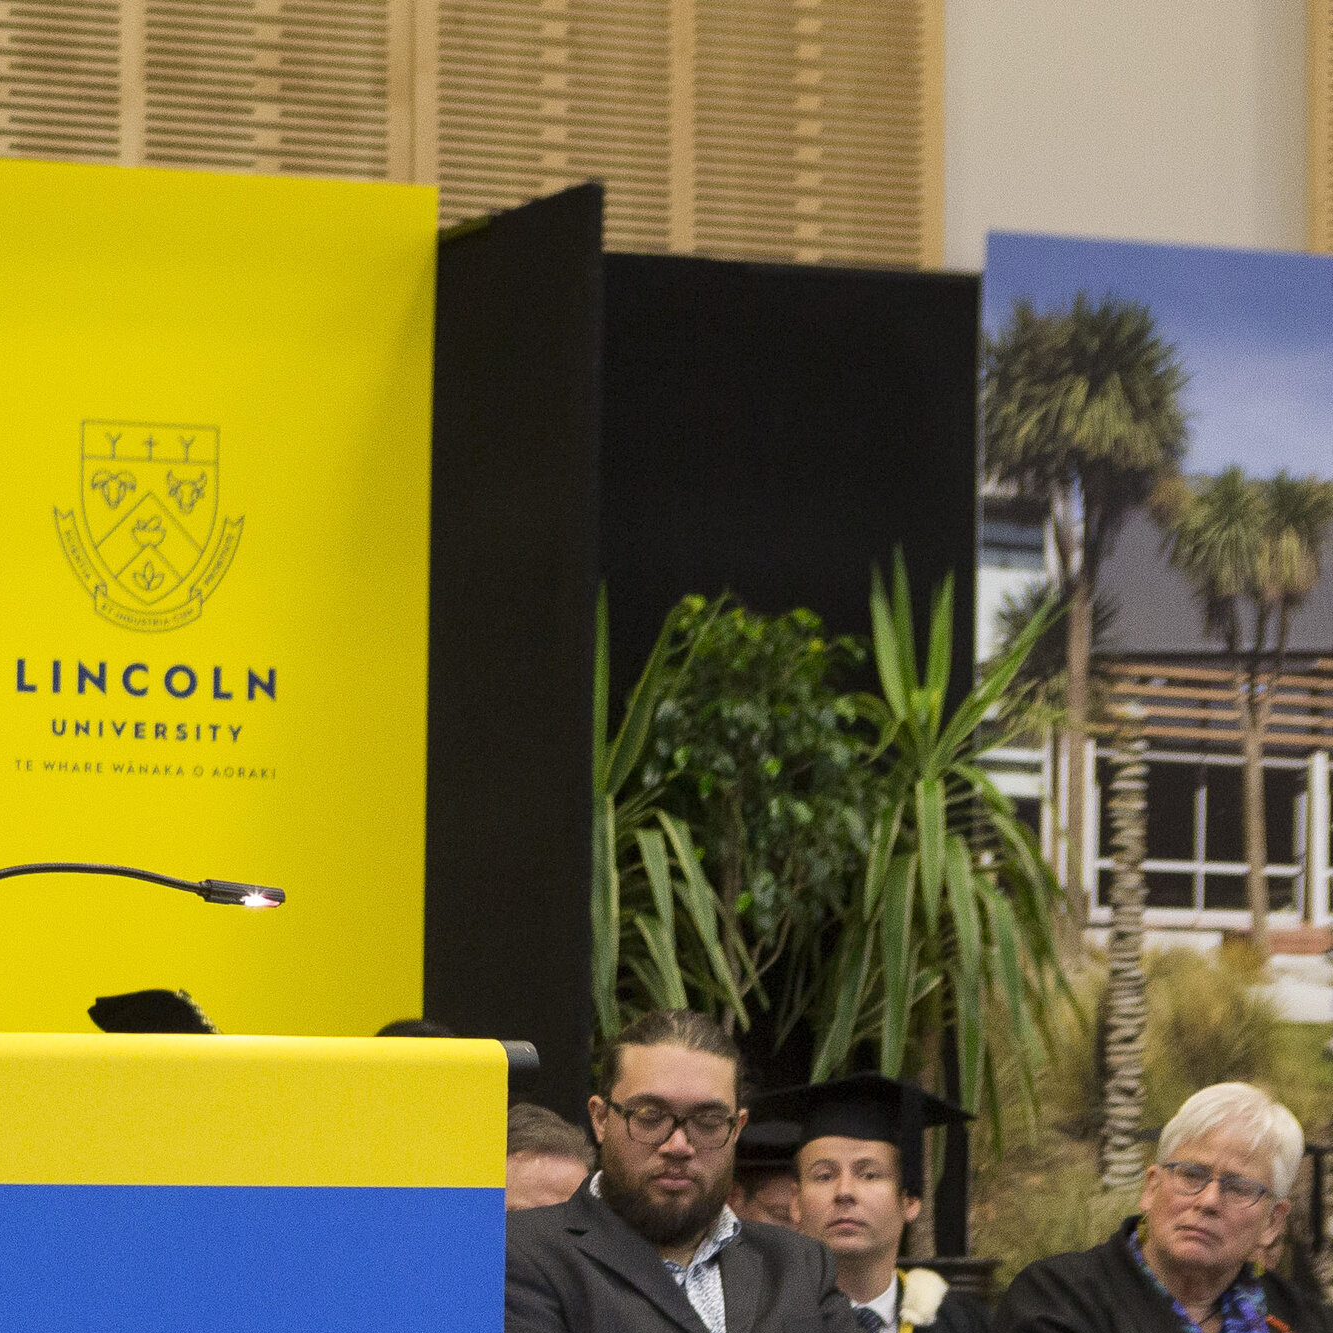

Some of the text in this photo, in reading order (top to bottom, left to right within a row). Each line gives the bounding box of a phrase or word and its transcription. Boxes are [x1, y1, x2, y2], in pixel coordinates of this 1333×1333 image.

[16, 658, 277, 701] LINCOLN
[51, 719, 243, 743] UNIVERSITY
[14, 759, 33, 772] TE
[43, 760, 103, 774] WHARE
[192, 765, 205, 778] O
[211, 767, 277, 780] AORAKI
